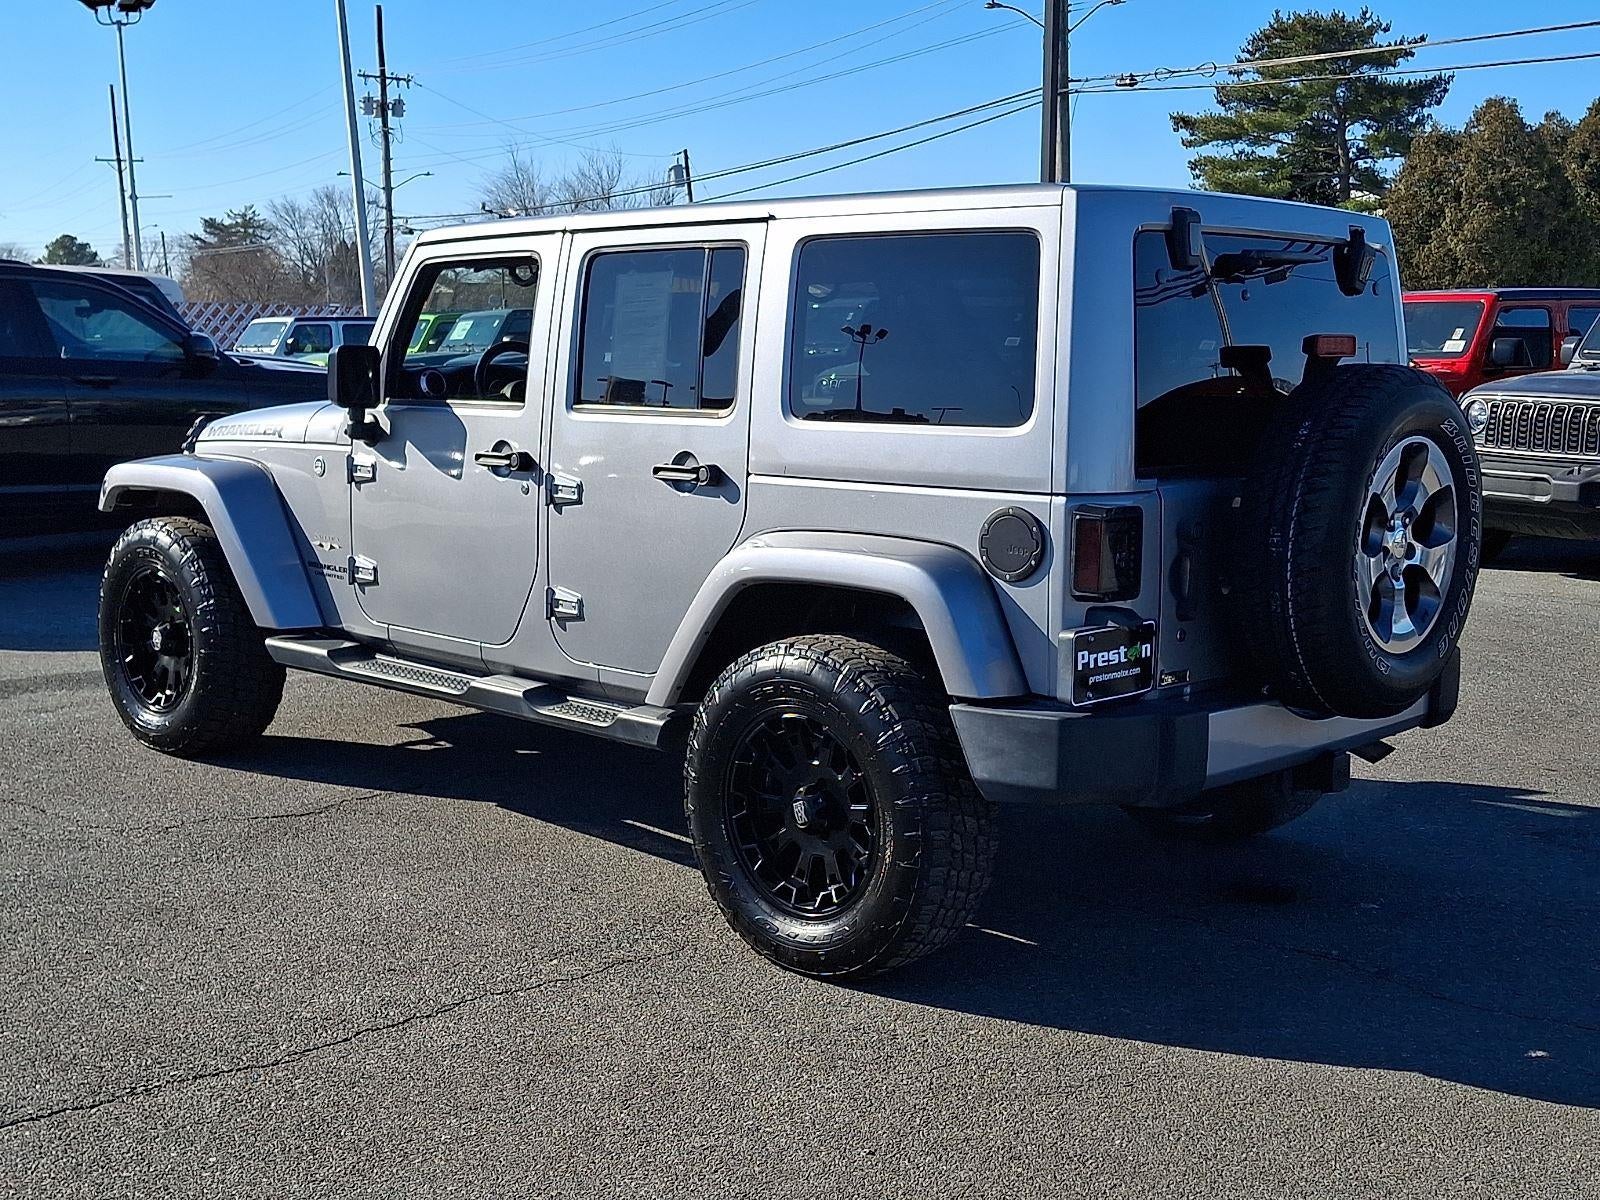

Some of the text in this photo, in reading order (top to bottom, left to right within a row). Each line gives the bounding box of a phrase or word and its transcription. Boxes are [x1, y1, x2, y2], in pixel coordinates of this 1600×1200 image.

[206, 424, 283, 438] WRANGLER
[1439, 418, 1480, 658] BRIDGESTONE
[1007, 545, 1029, 557] Jeep
[1077, 642, 1151, 671] Preston
[1088, 667, 1141, 686] prestonmotor.com
